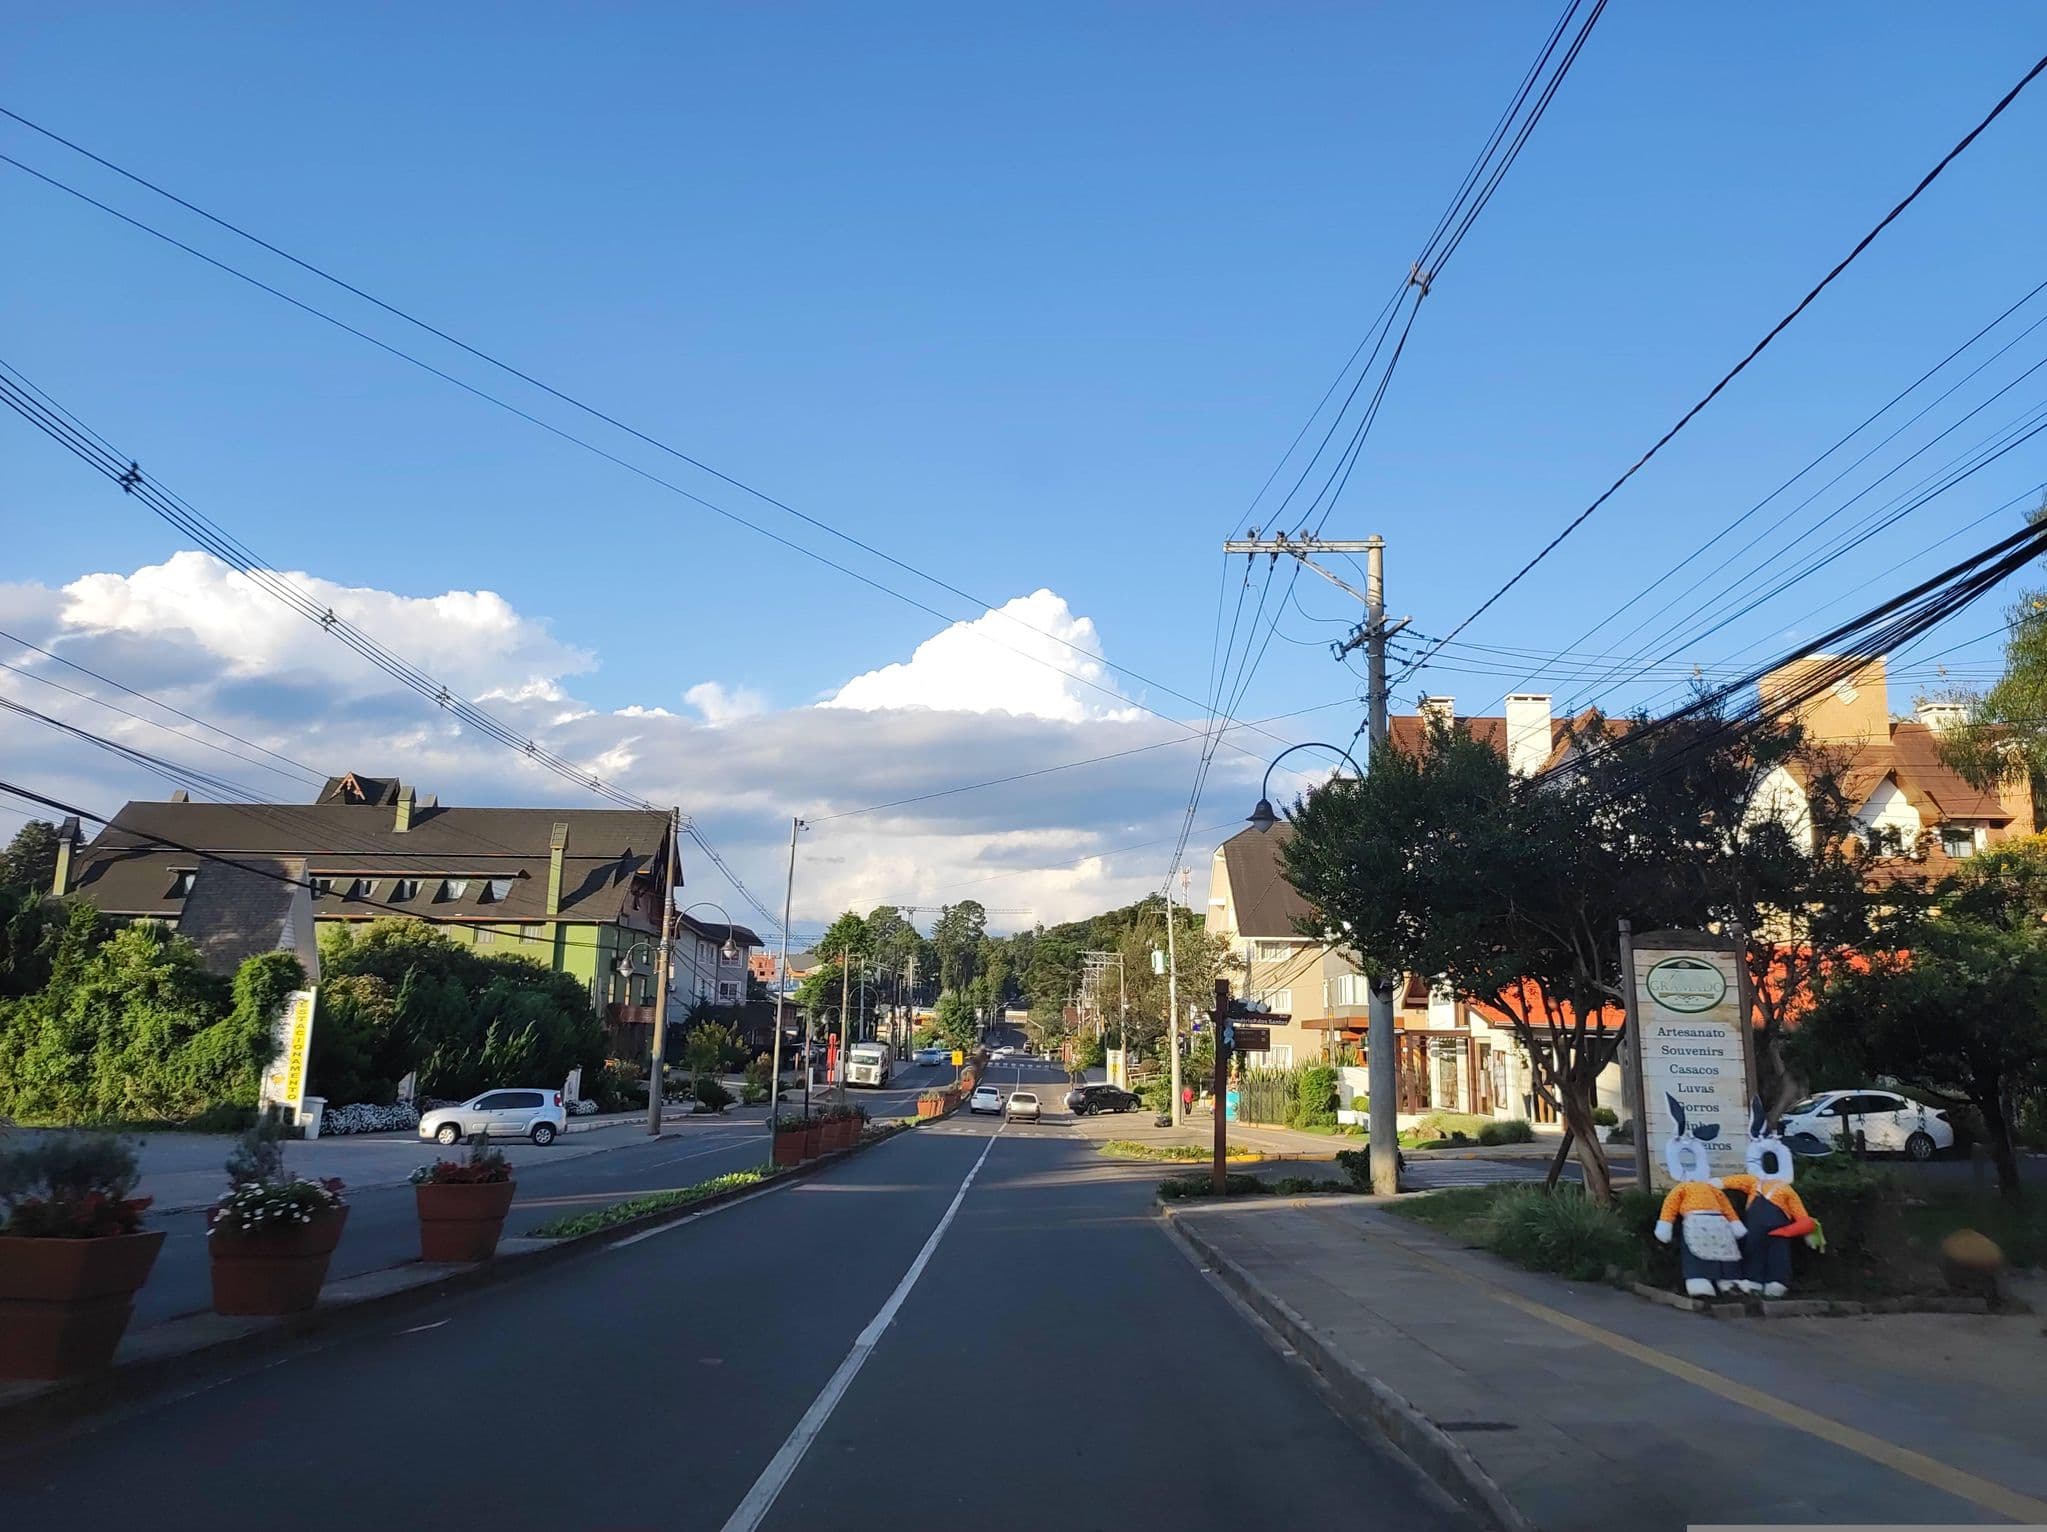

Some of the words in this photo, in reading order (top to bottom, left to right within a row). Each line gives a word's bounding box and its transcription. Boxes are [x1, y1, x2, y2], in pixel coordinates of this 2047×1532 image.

[1657, 1027, 1726, 1038] Artesanato
[287, 1000, 308, 1100] ESTACIONAMENTO
[1661, 1045, 1724, 1056] Souvenirs
[1669, 1063, 1720, 1075] Casacos
[1677, 1083, 1715, 1093] Luvas
